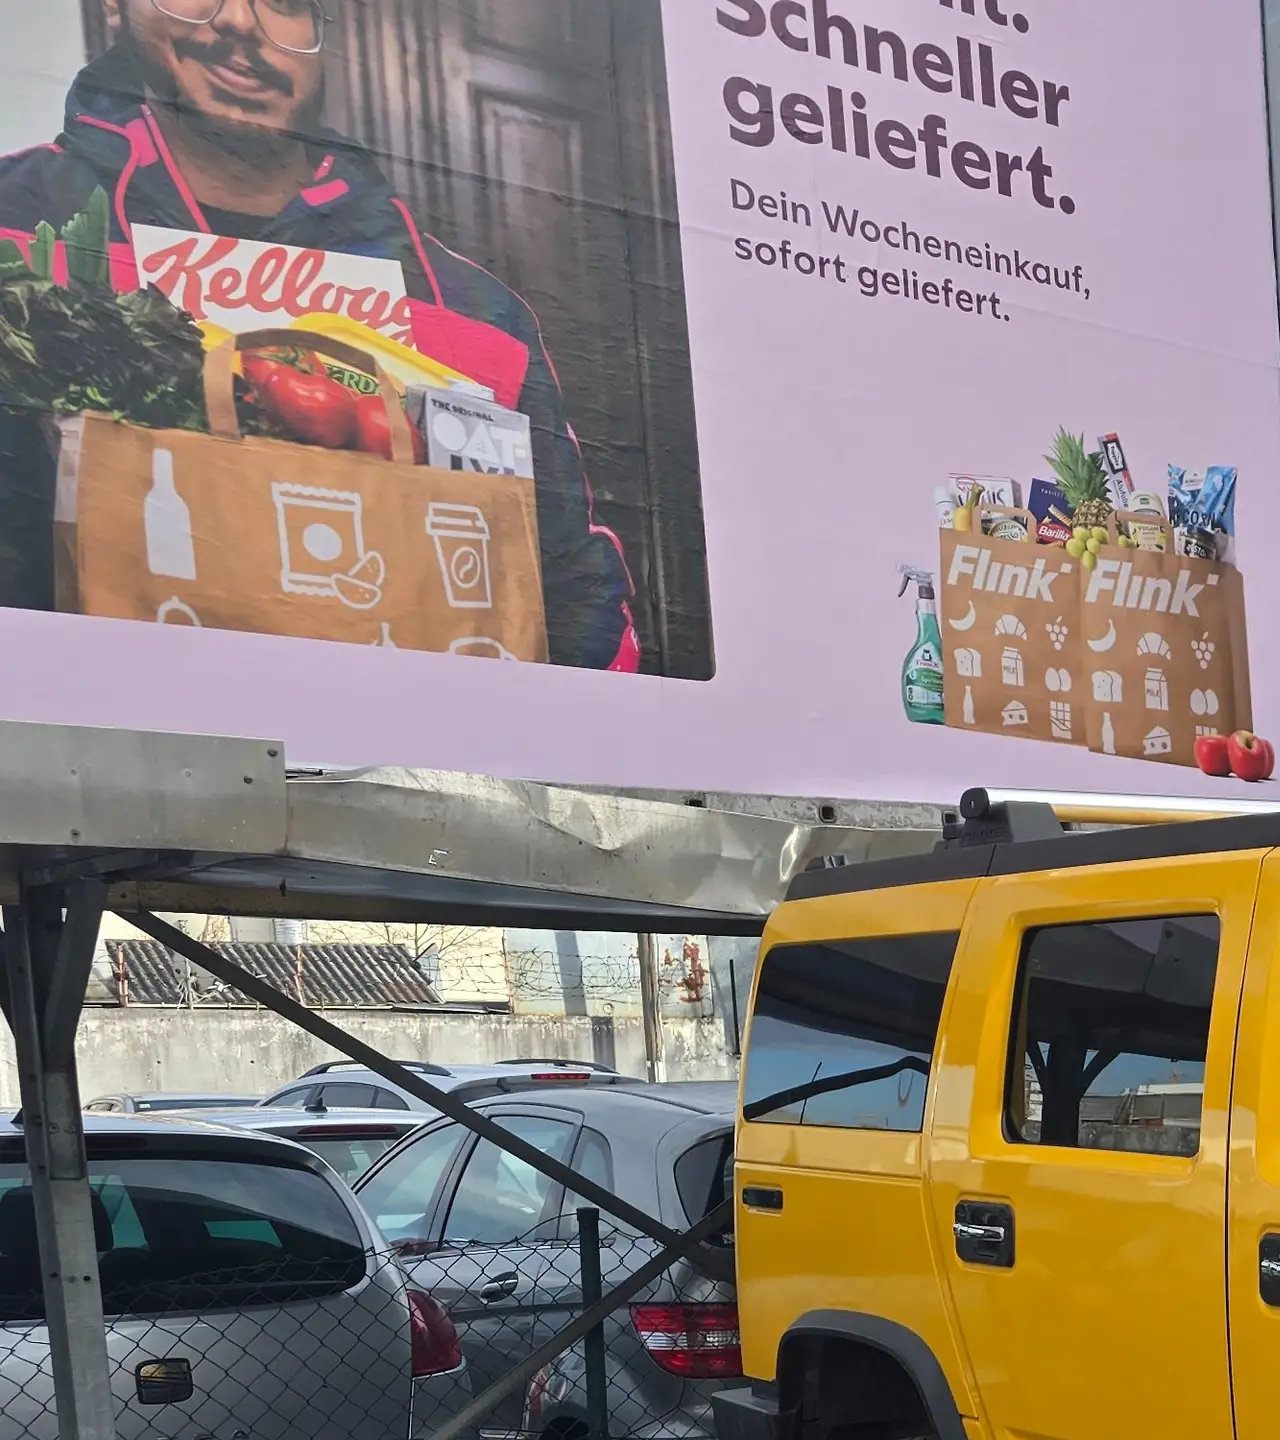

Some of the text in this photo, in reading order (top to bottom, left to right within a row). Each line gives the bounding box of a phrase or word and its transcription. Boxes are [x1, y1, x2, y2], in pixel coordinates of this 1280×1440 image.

[722, 76, 1076, 215] geliefert.
[730, 178, 1091, 300] Dein Wocheneinkauf,
[734, 236, 1011, 322] sofort geliefert.
[431, 398, 494, 422] THE ORIGINAL
[1037, 525, 1070, 542] Barilla
[947, 544, 1072, 602] Flink
[1085, 558, 1219, 617] Flink
